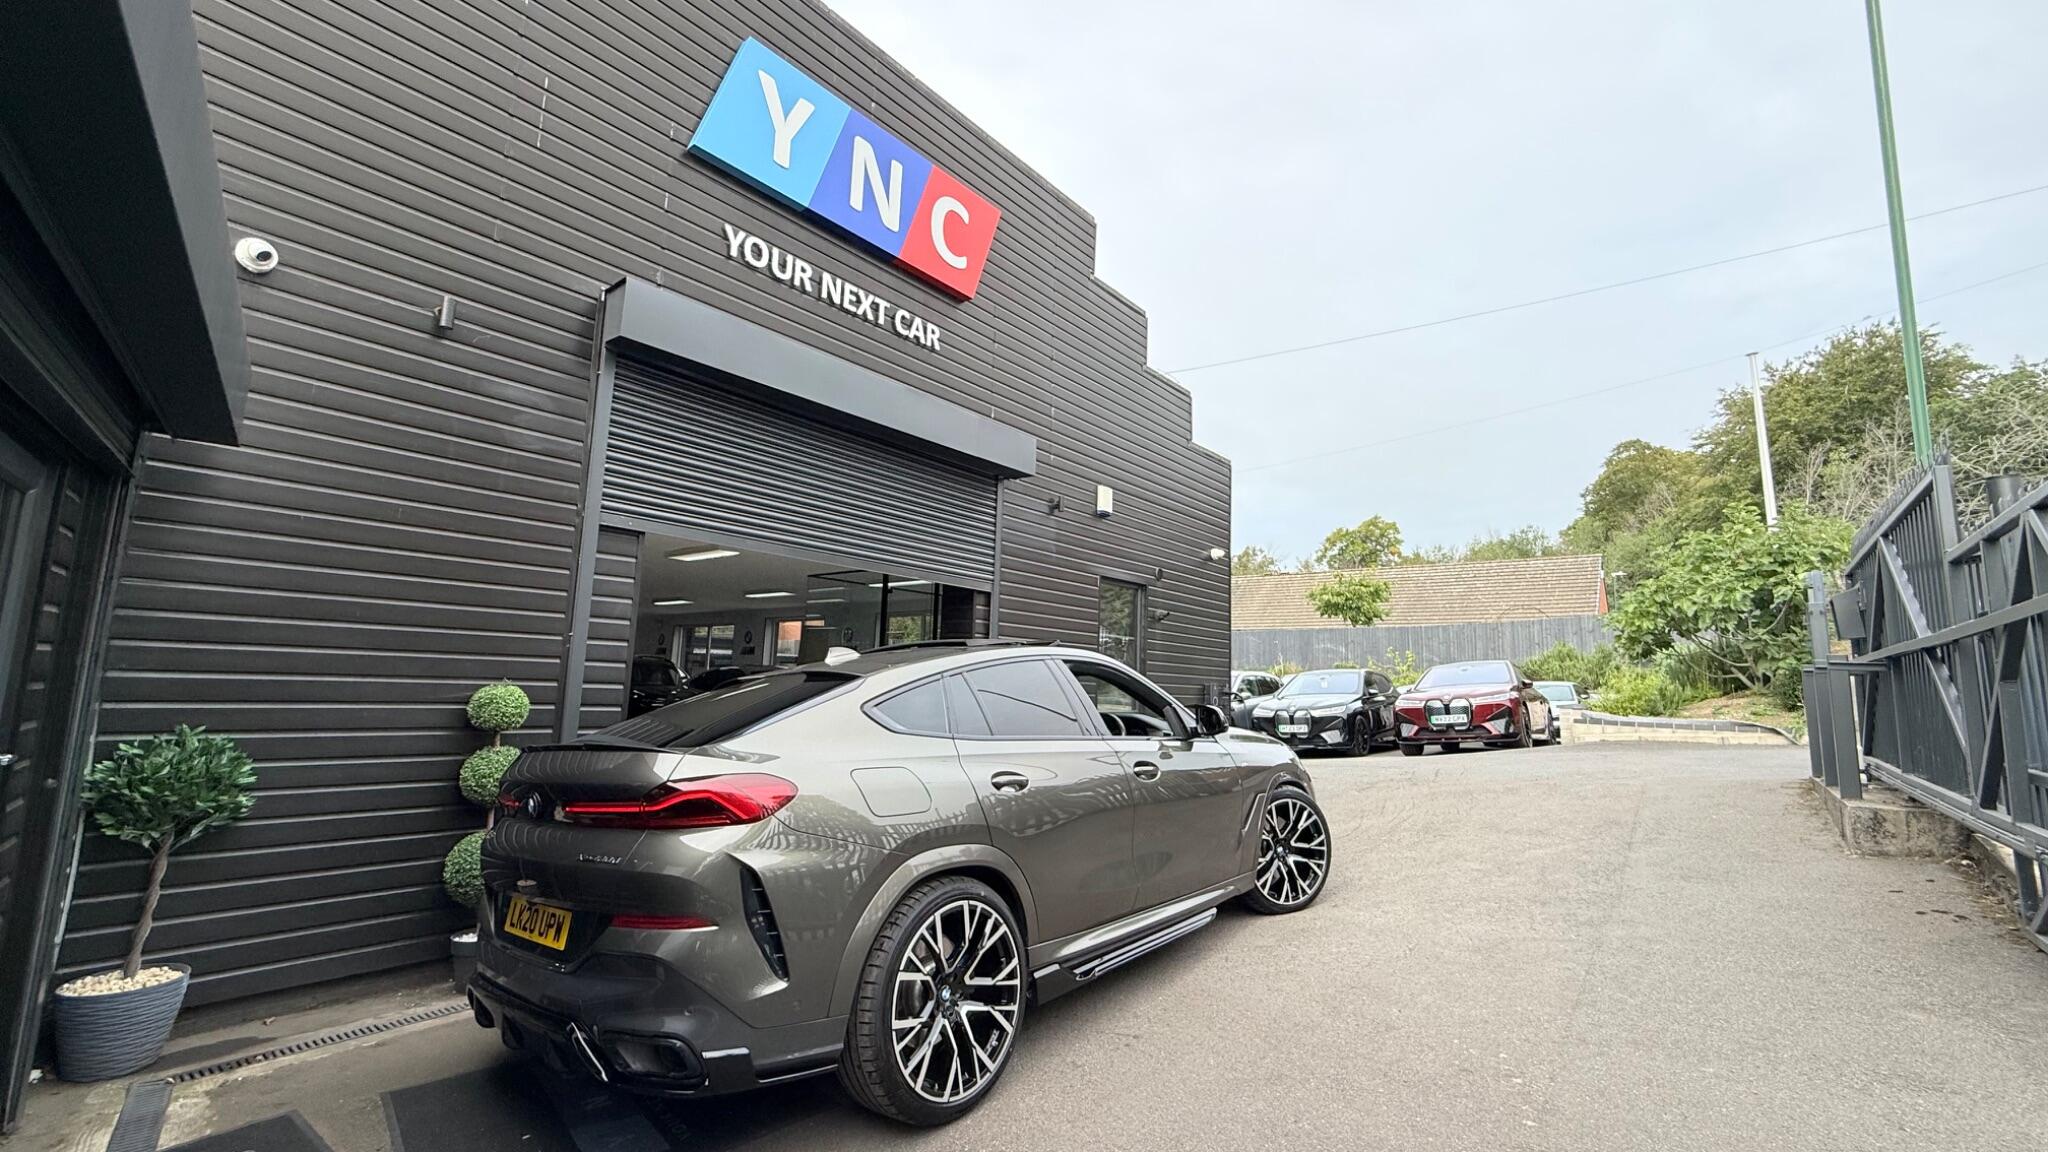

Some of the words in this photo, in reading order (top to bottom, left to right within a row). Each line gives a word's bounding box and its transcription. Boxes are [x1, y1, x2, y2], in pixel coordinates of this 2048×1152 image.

[758, 69, 970, 270] YNC
[723, 223, 813, 293] YOUR
[821, 271, 891, 327] NEXT
[894, 309, 941, 351] CAR
[509, 901, 539, 934] LK20
